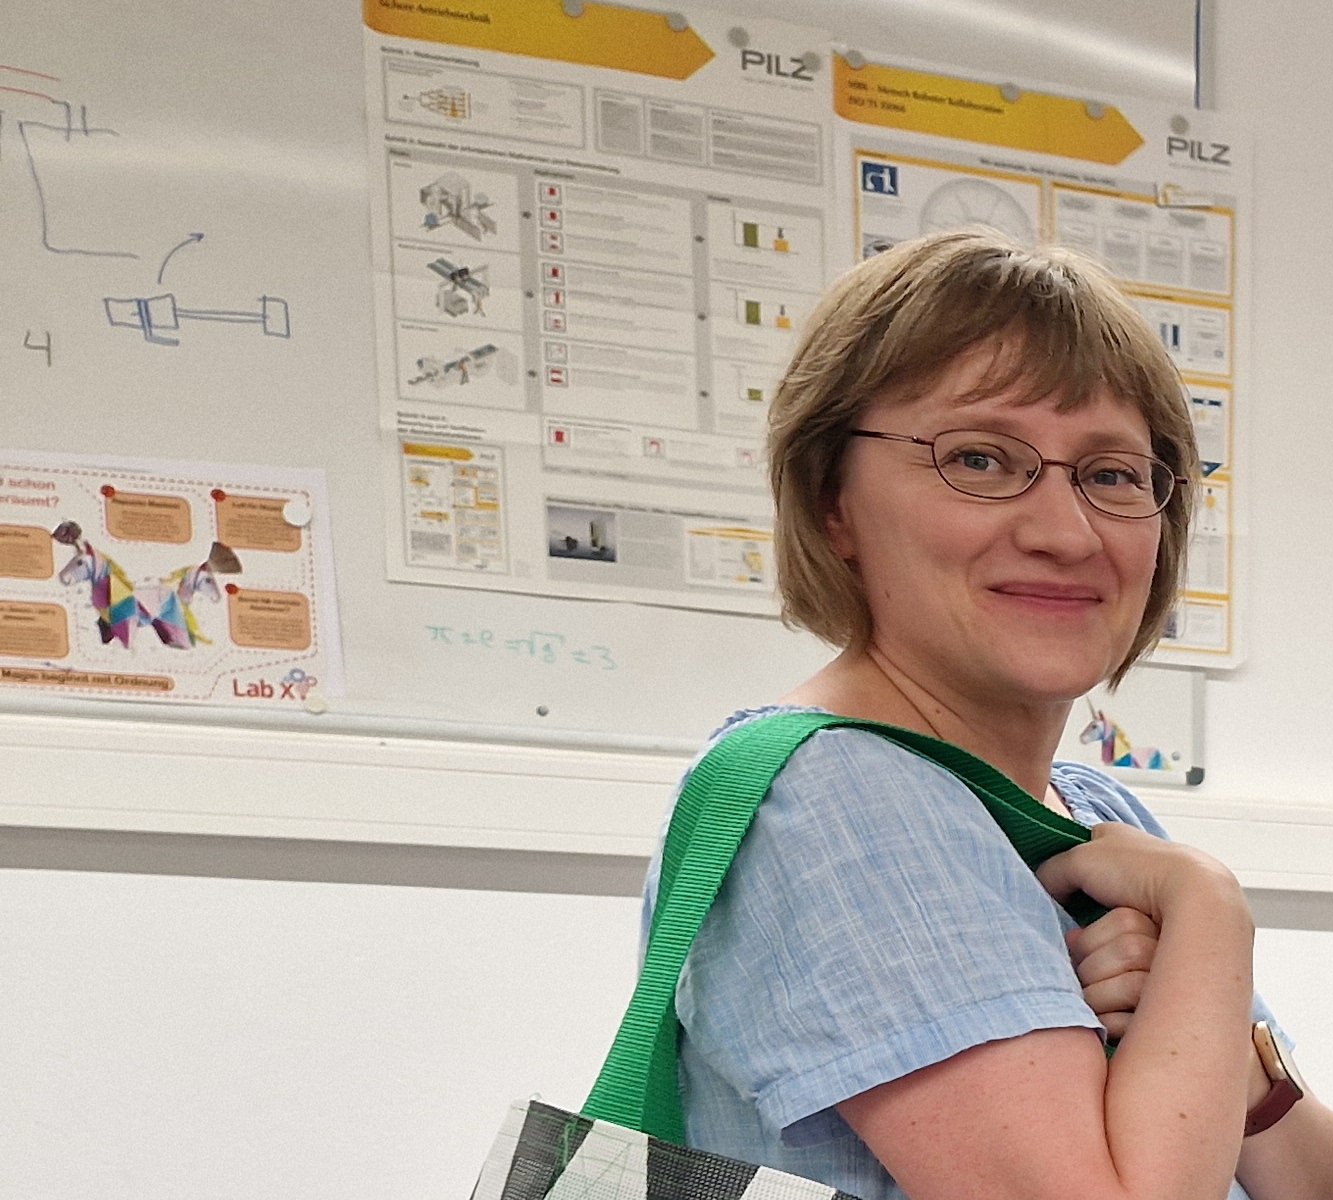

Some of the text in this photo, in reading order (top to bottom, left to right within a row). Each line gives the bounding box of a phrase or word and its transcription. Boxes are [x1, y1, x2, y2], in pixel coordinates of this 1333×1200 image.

[742, 50, 814, 81] PILZ
[1166, 136, 1231, 166] PILZ
[24, 330, 51, 367] 4
[233, 679, 274, 698] Lab
